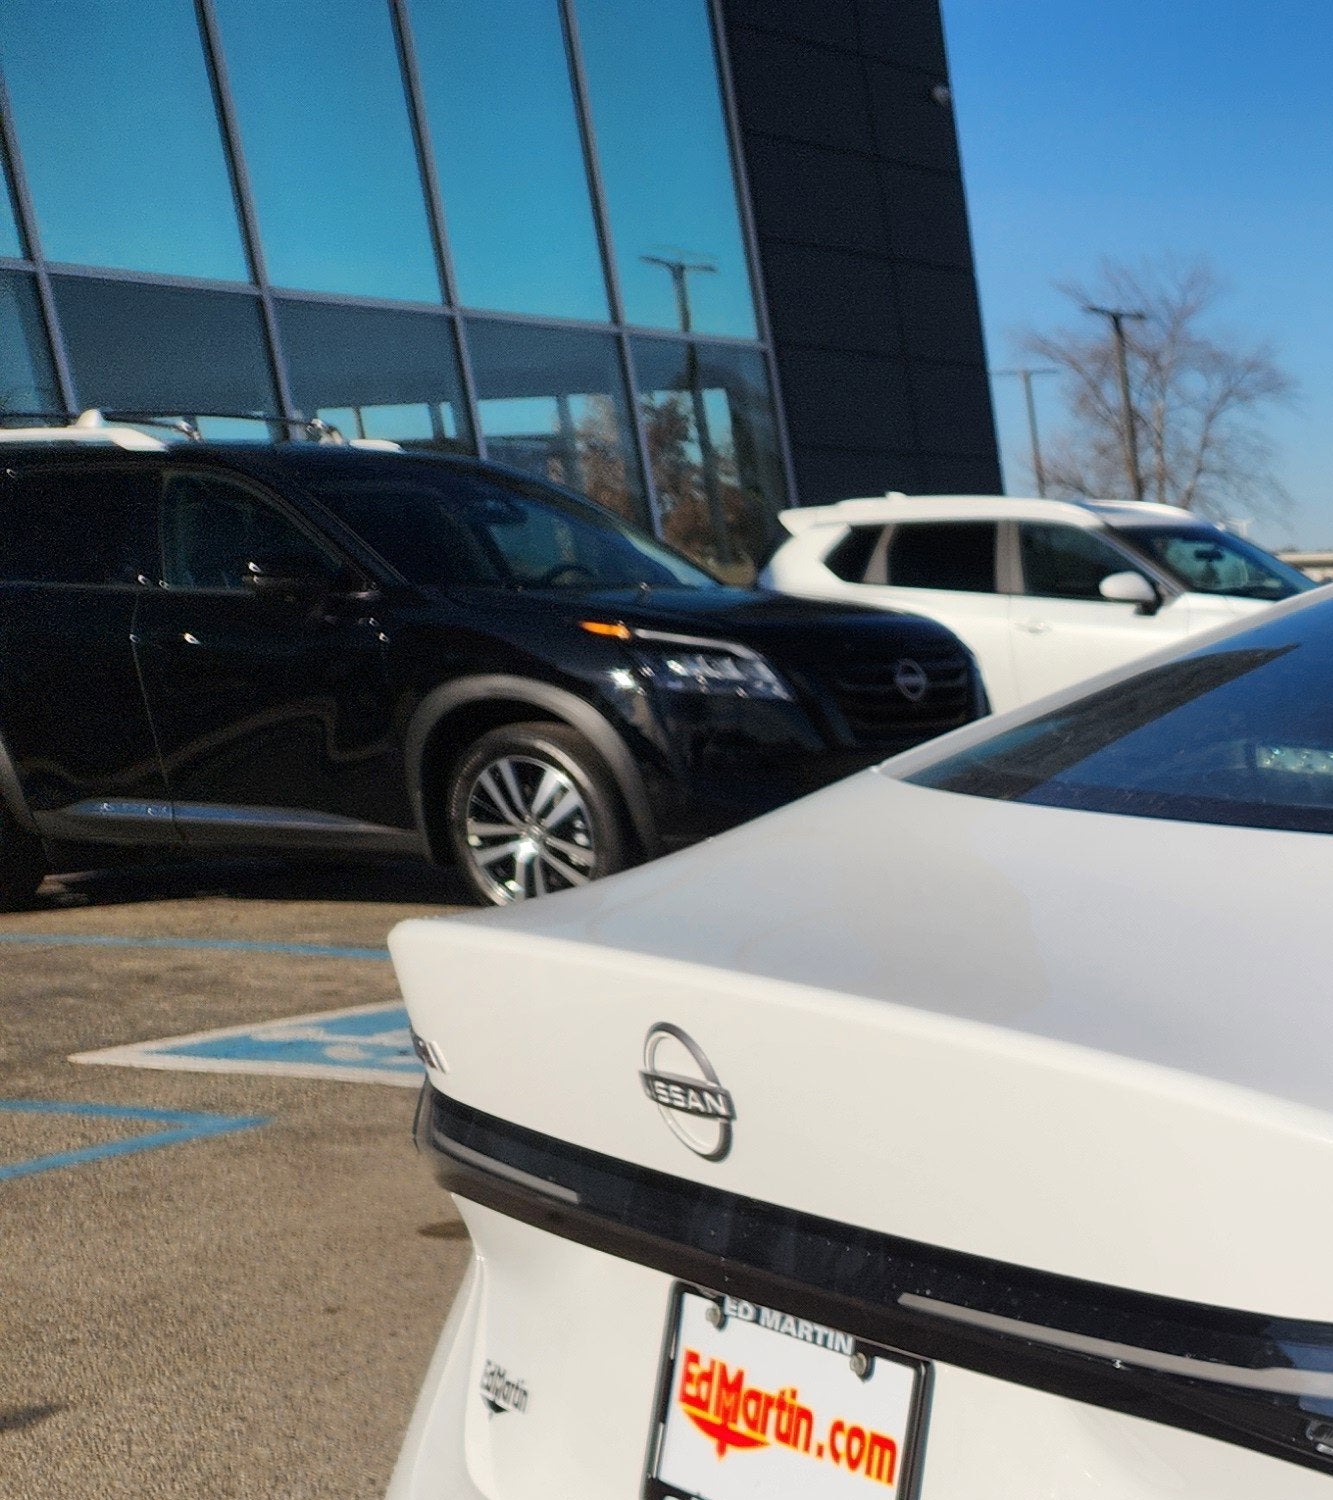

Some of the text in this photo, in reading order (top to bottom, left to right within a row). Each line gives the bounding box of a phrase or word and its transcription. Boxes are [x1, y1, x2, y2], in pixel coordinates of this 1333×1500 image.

[724, 1296, 856, 1355] ED MARTIN
[679, 1348, 898, 1486] EdMartin.com
